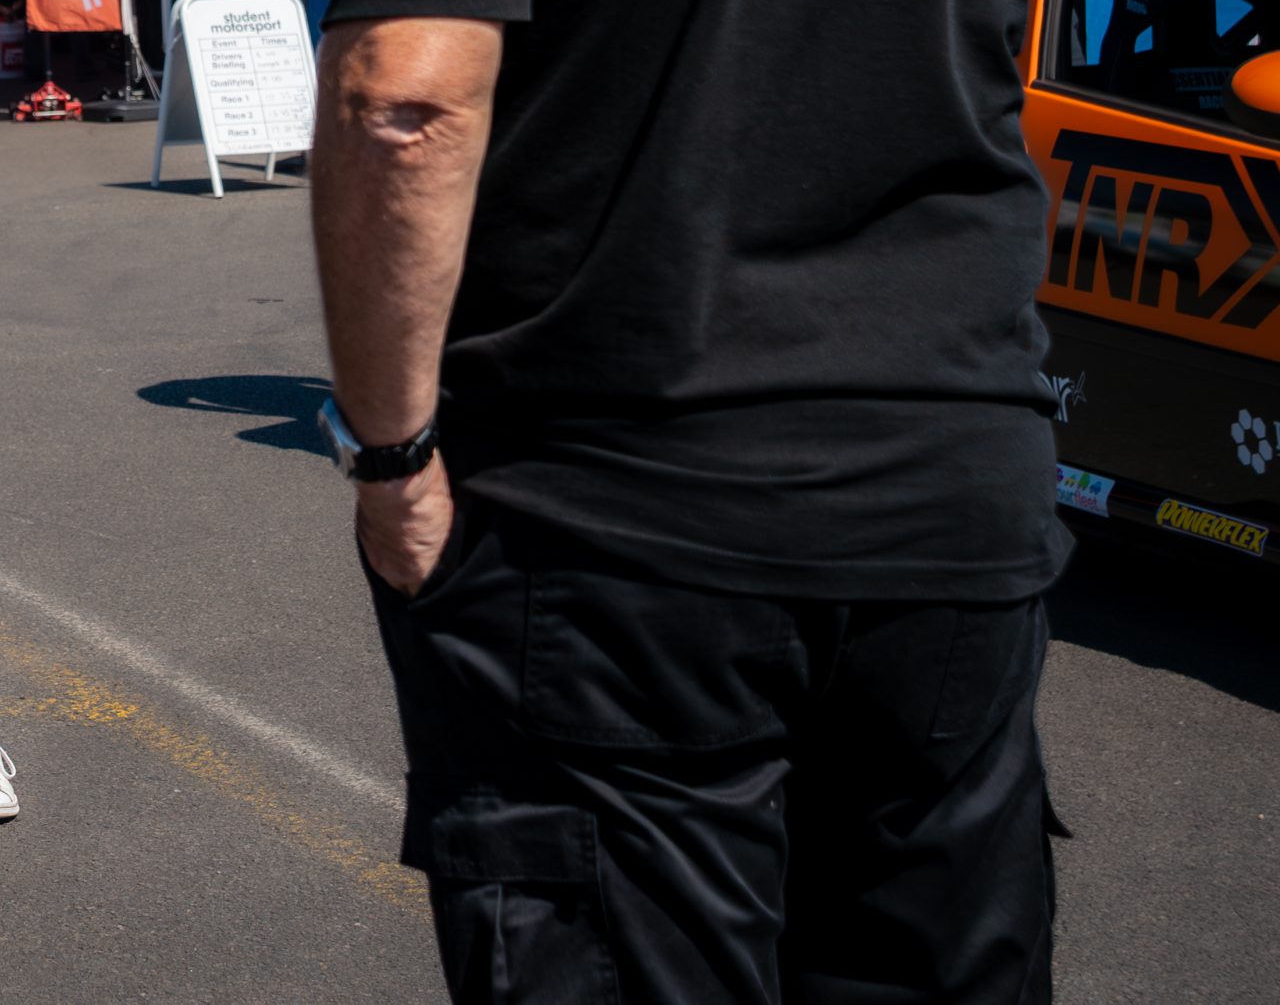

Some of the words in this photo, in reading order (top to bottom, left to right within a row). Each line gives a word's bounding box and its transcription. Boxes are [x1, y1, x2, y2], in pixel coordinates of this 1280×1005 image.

[223, 10, 270, 24] student
[210, 20, 282, 33] motorsport
[211, 53, 242, 61] Drivers
[212, 61, 246, 70] Briefing
[210, 78, 255, 88] Qualifying
[1157, 499, 1267, 553] POWERFLEX
